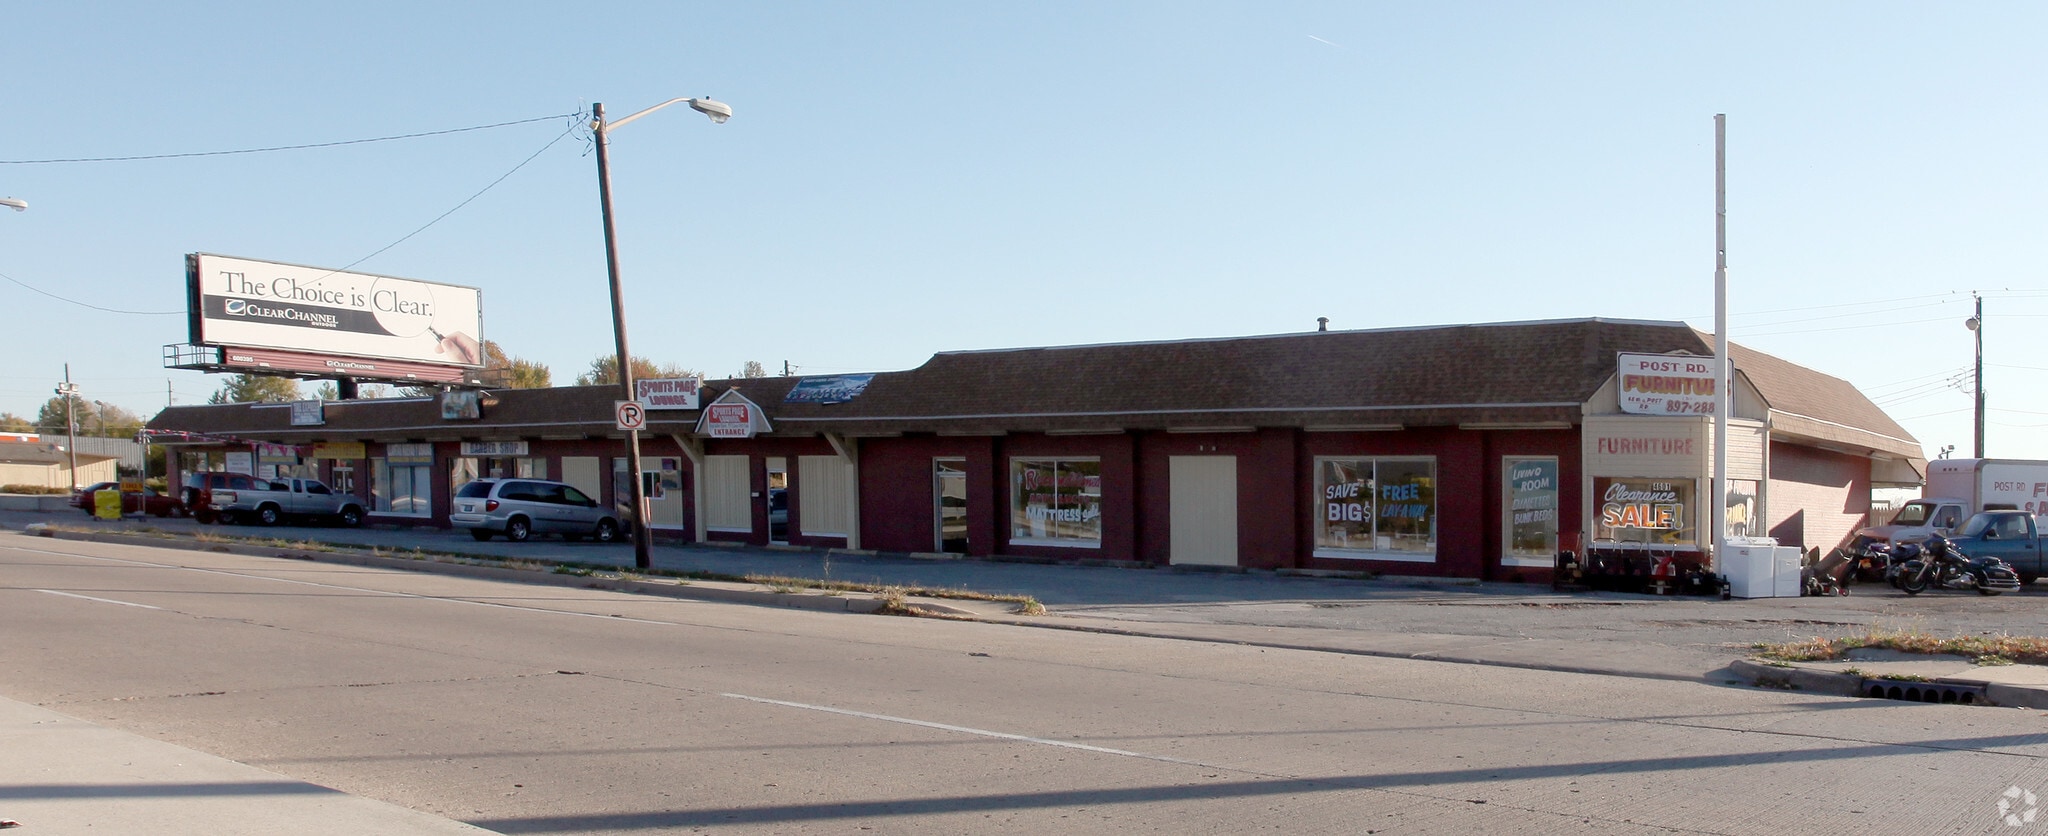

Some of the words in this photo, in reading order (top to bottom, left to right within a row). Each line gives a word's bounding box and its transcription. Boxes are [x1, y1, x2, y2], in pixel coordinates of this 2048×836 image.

[219, 271, 265, 296] The
[272, 278, 344, 304] Choice
[350, 287, 365, 307] is
[373, 290, 433, 316] Clear.
[1640, 361, 1680, 372] POST
[1686, 364, 1709, 374] RD.
[640, 380, 673, 398] SPORTS
[674, 380, 697, 396] PAGE
[1623, 374, 1731, 397] FURNITU
[648, 395, 688, 406] LOUNGE
[499, 442, 519, 454] SHOP
[1598, 437, 1693, 455] FURNITURE
[1326, 482, 1360, 499] SAVE
[1382, 483, 1419, 500] FREE
[1521, 477, 1550, 492] ROOM
[1604, 483, 1676, 501] Clearance
[1994, 481, 2014, 492] POST
[2016, 482, 2026, 492] RD
[1025, 506, 1081, 522] MATTRESS
[1514, 511, 1533, 525] BUNK
[1533, 508, 1553, 522] BEDS
[1602, 503, 1684, 530] SALE!
